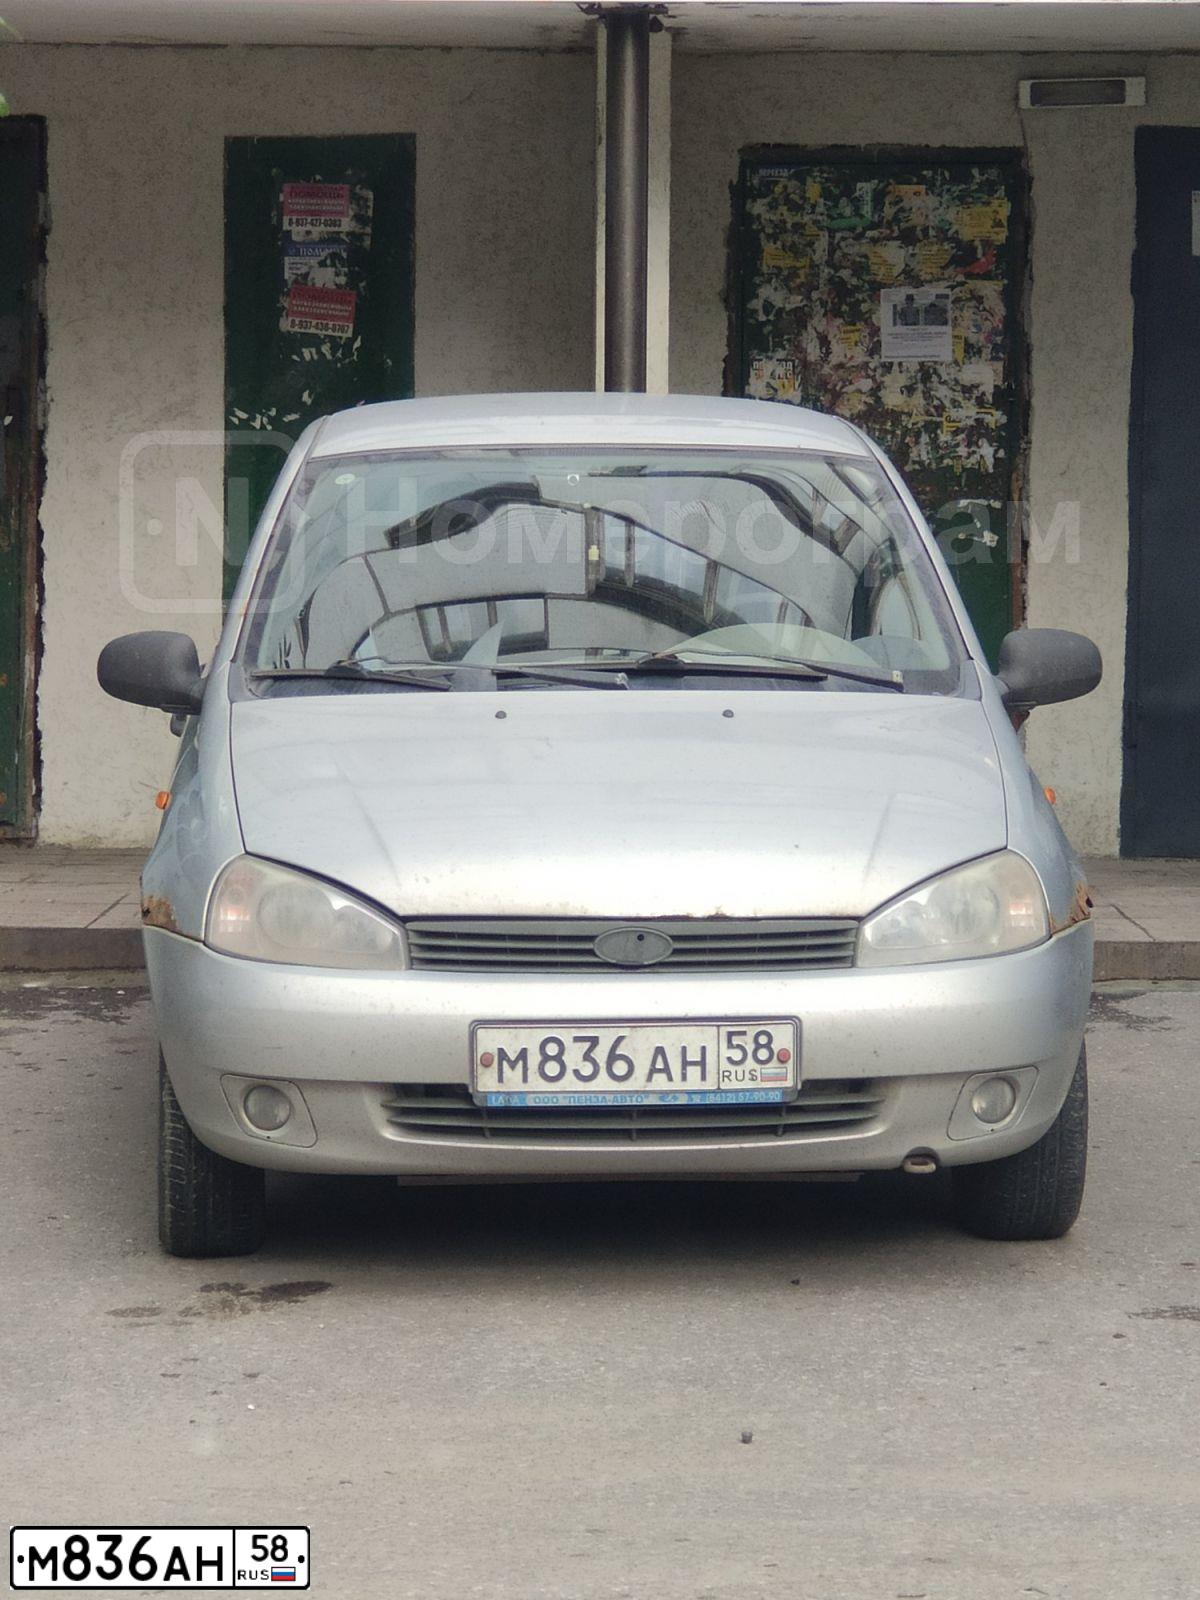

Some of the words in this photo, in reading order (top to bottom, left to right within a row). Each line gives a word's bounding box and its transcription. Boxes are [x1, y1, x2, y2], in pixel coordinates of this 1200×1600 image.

[497, 1035, 707, 1084] М836АН
[725, 1029, 774, 1066] 58
[722, 1068, 758, 1083] RUS
[534, 1095, 559, 1104] ООО
